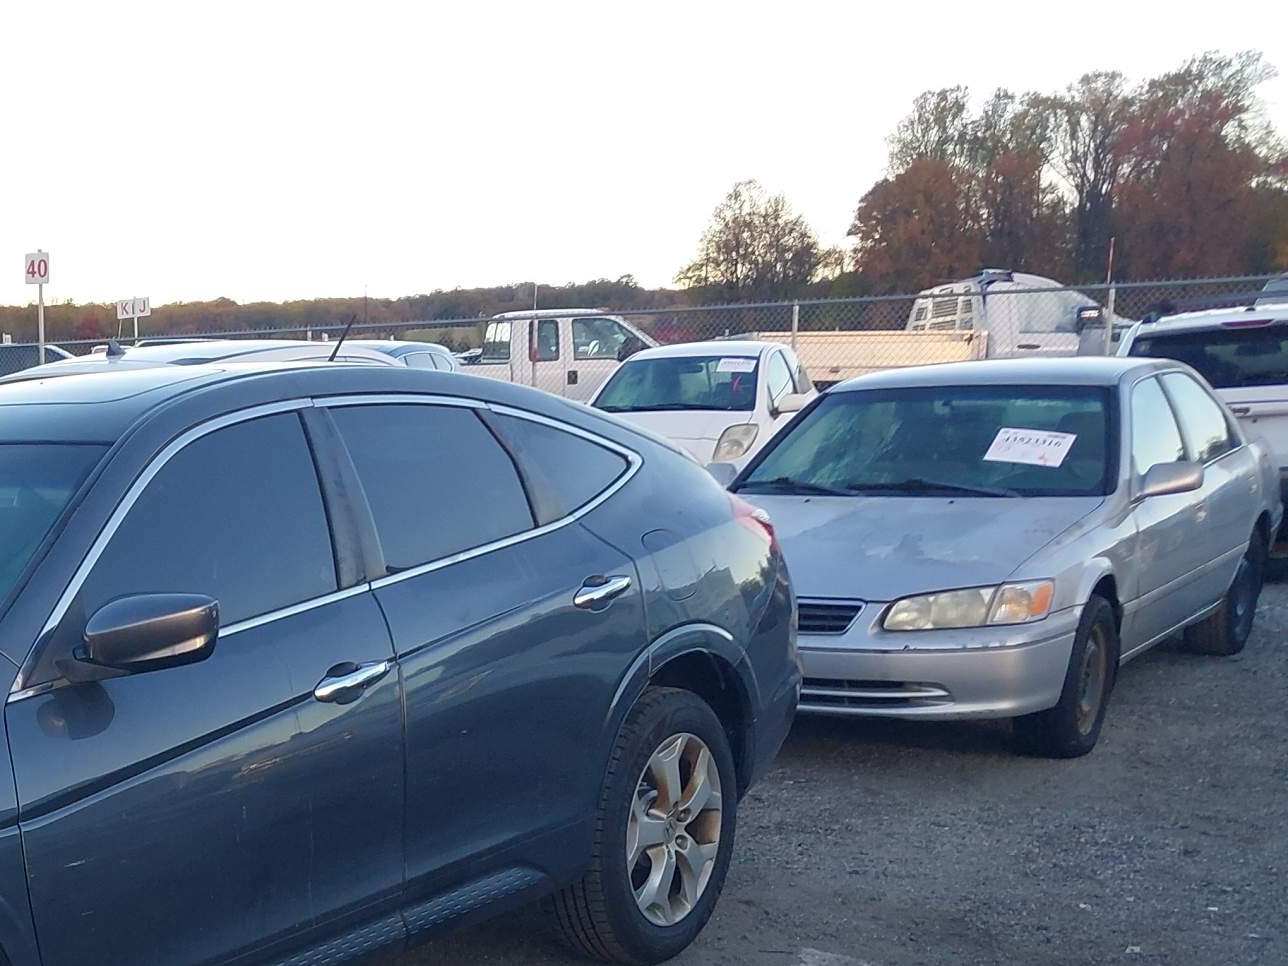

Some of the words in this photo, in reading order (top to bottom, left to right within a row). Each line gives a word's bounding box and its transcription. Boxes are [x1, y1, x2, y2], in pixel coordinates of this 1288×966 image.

[26, 259, 48, 278] 40
[120, 303, 129, 316] K
[139, 300, 146, 313] J
